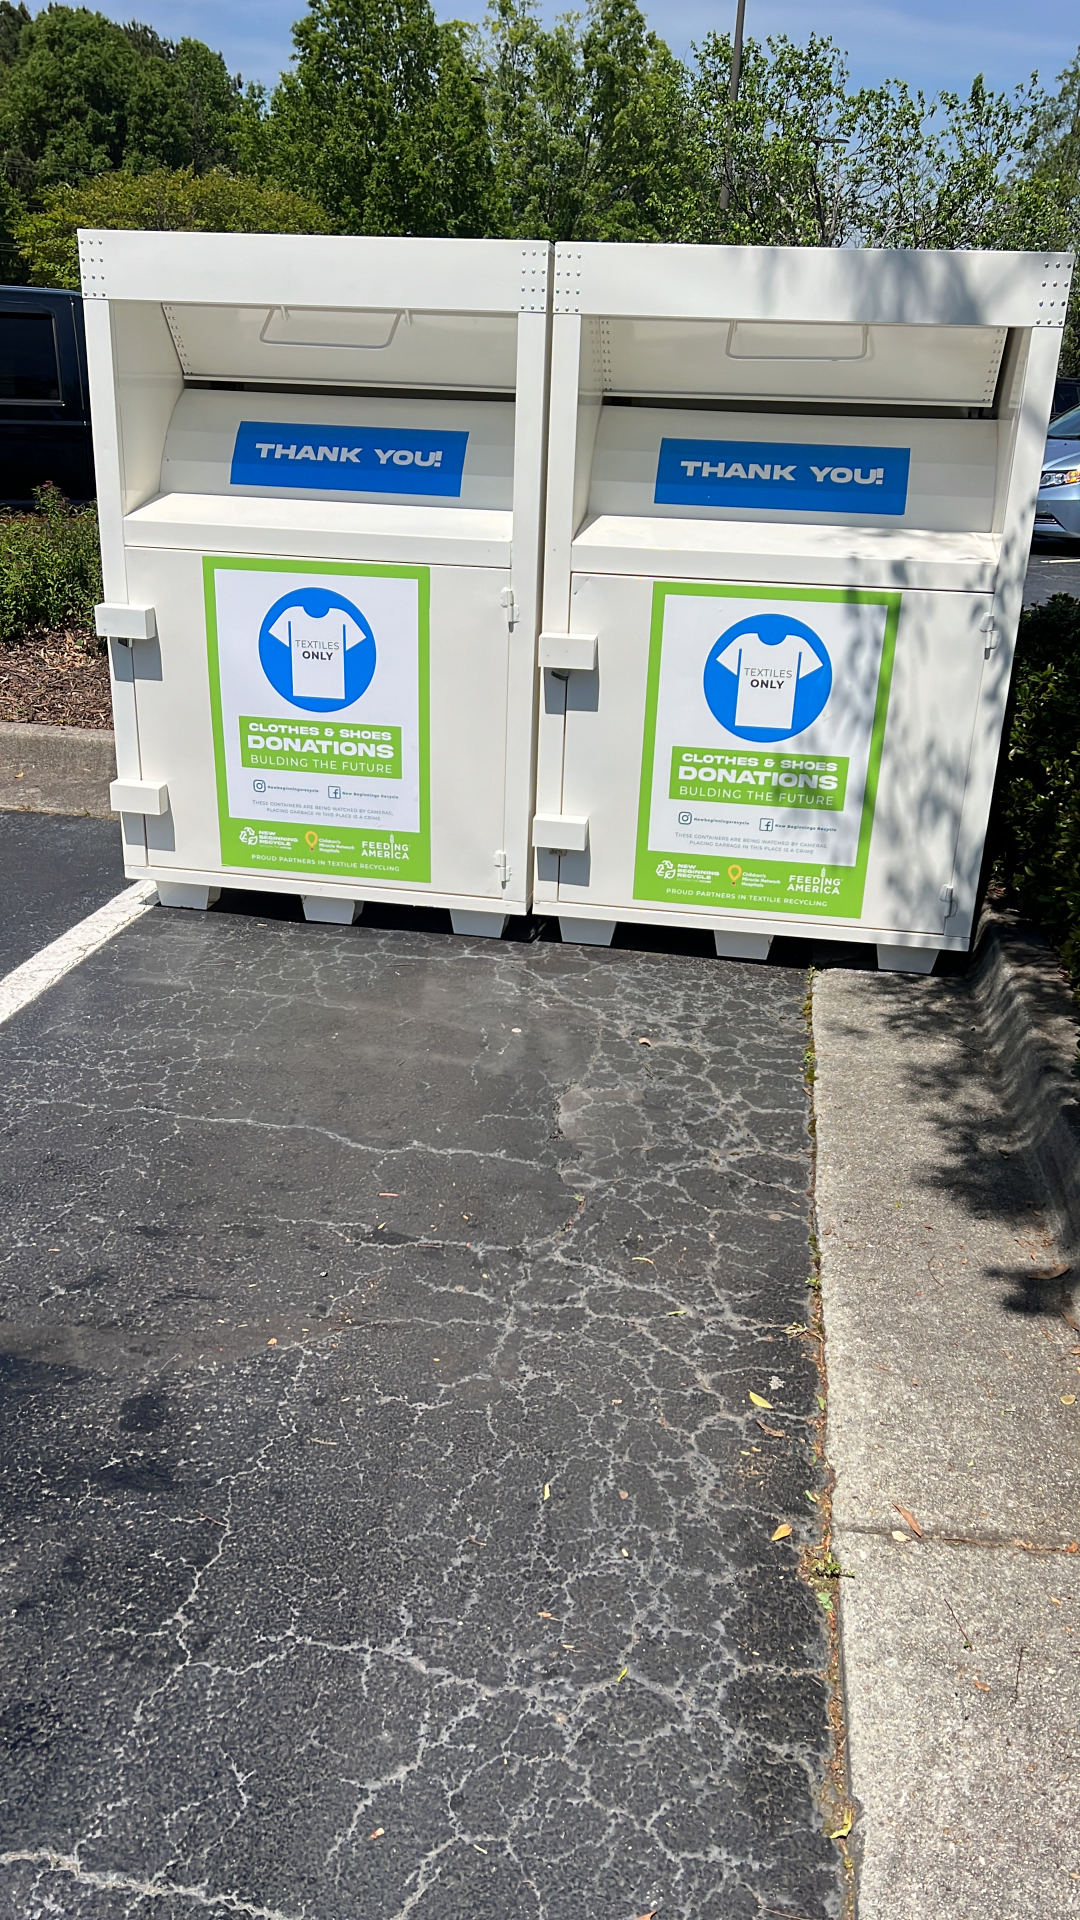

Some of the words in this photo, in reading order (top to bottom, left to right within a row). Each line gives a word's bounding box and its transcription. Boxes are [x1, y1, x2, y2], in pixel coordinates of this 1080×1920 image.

[255, 443, 363, 463] THANK
[374, 448, 443, 468] YOU!
[680, 460, 797, 481] THANK
[809, 466, 884, 485] YOU!
[295, 640, 340, 650] TEXTILES
[302, 650, 333, 661] ONLY
[744, 668, 793, 679] TEXTILES
[750, 679, 785, 689] ONLY
[249, 722, 320, 736] CLOTHES
[324, 728, 335, 737] &
[340, 729, 392, 741] SHOES
[248, 735, 394, 759] DONATIONS
[250, 754, 308, 768] BULDING
[312, 759, 337, 770] THE
[342, 762, 393, 774] FUTURE
[682, 753, 759, 767] CLOTHES
[764, 758, 775, 768] &
[780, 759, 838, 772] SHOES
[678, 766, 839, 790] DONATIONS
[679, 786, 742, 799] BULDING
[747, 790, 773, 802] THE
[778, 793, 834, 806] FUTURE
[259, 835, 299, 843] BEGINNING
[694, 834, 729, 842] CONTAINERS
[362, 839, 409, 852] FEEDING
[361, 849, 410, 860] AMERICA
[251, 854, 277, 862] PROUD
[279, 857, 316, 865] PARTNERS
[328, 860, 358, 869] TEXTILIE
[360, 863, 400, 872] RECYCLING
[677, 868, 720, 876] BEGINNING
[789, 873, 841, 886] FEEDING
[787, 883, 840, 895] AMERICA
[666, 888, 694, 896] PROUD
[696, 891, 736, 900] PARTNERS
[749, 895, 782, 904] TEXTILIE
[783, 898, 828, 907] RECYCLING
